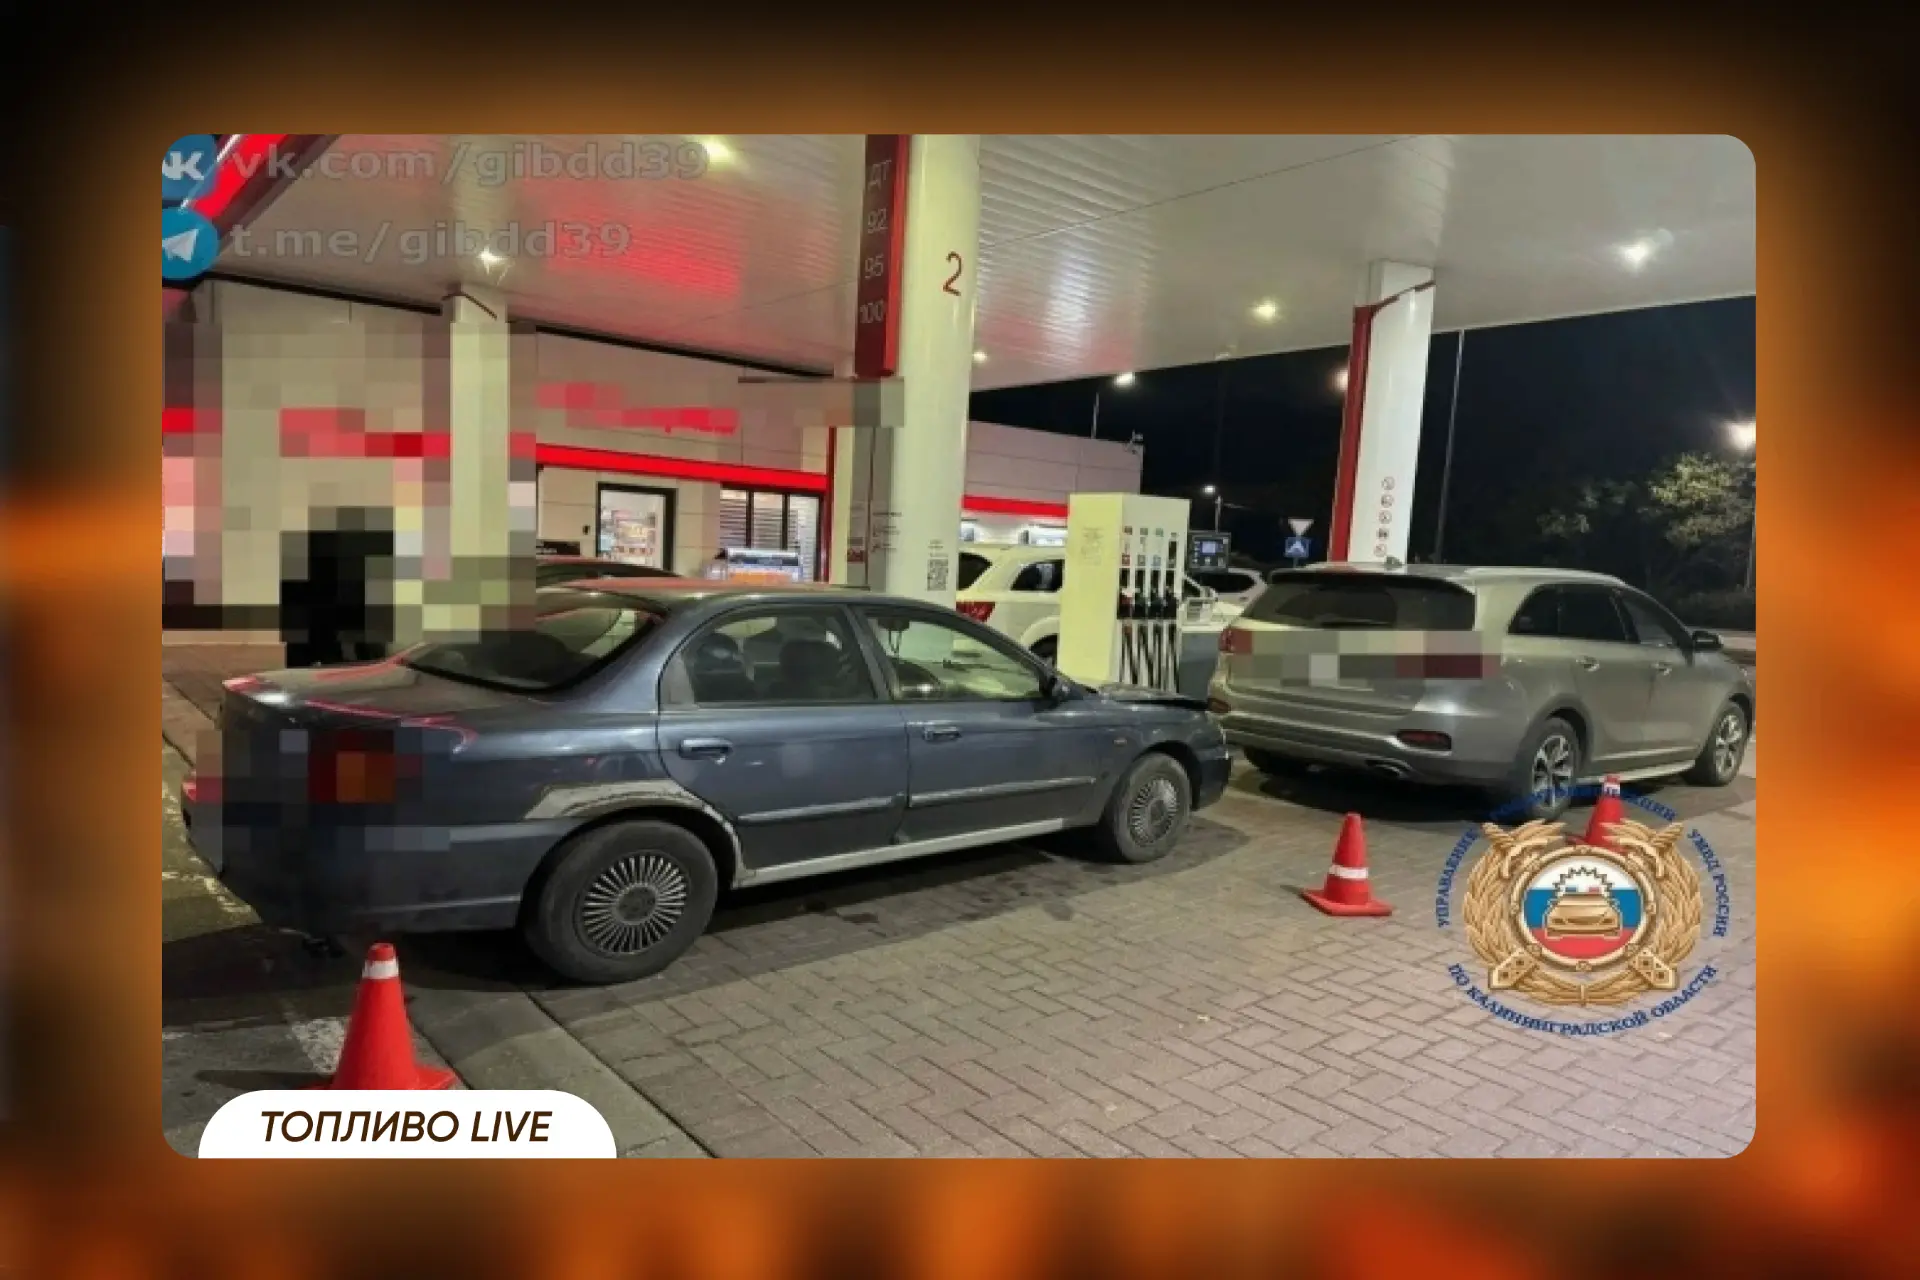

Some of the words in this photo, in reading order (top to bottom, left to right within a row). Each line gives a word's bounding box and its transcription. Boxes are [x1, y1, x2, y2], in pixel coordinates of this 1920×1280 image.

[867, 208, 888, 234] 92
[864, 254, 884, 279] 95
[943, 251, 962, 296] 2
[859, 300, 885, 324] 100
